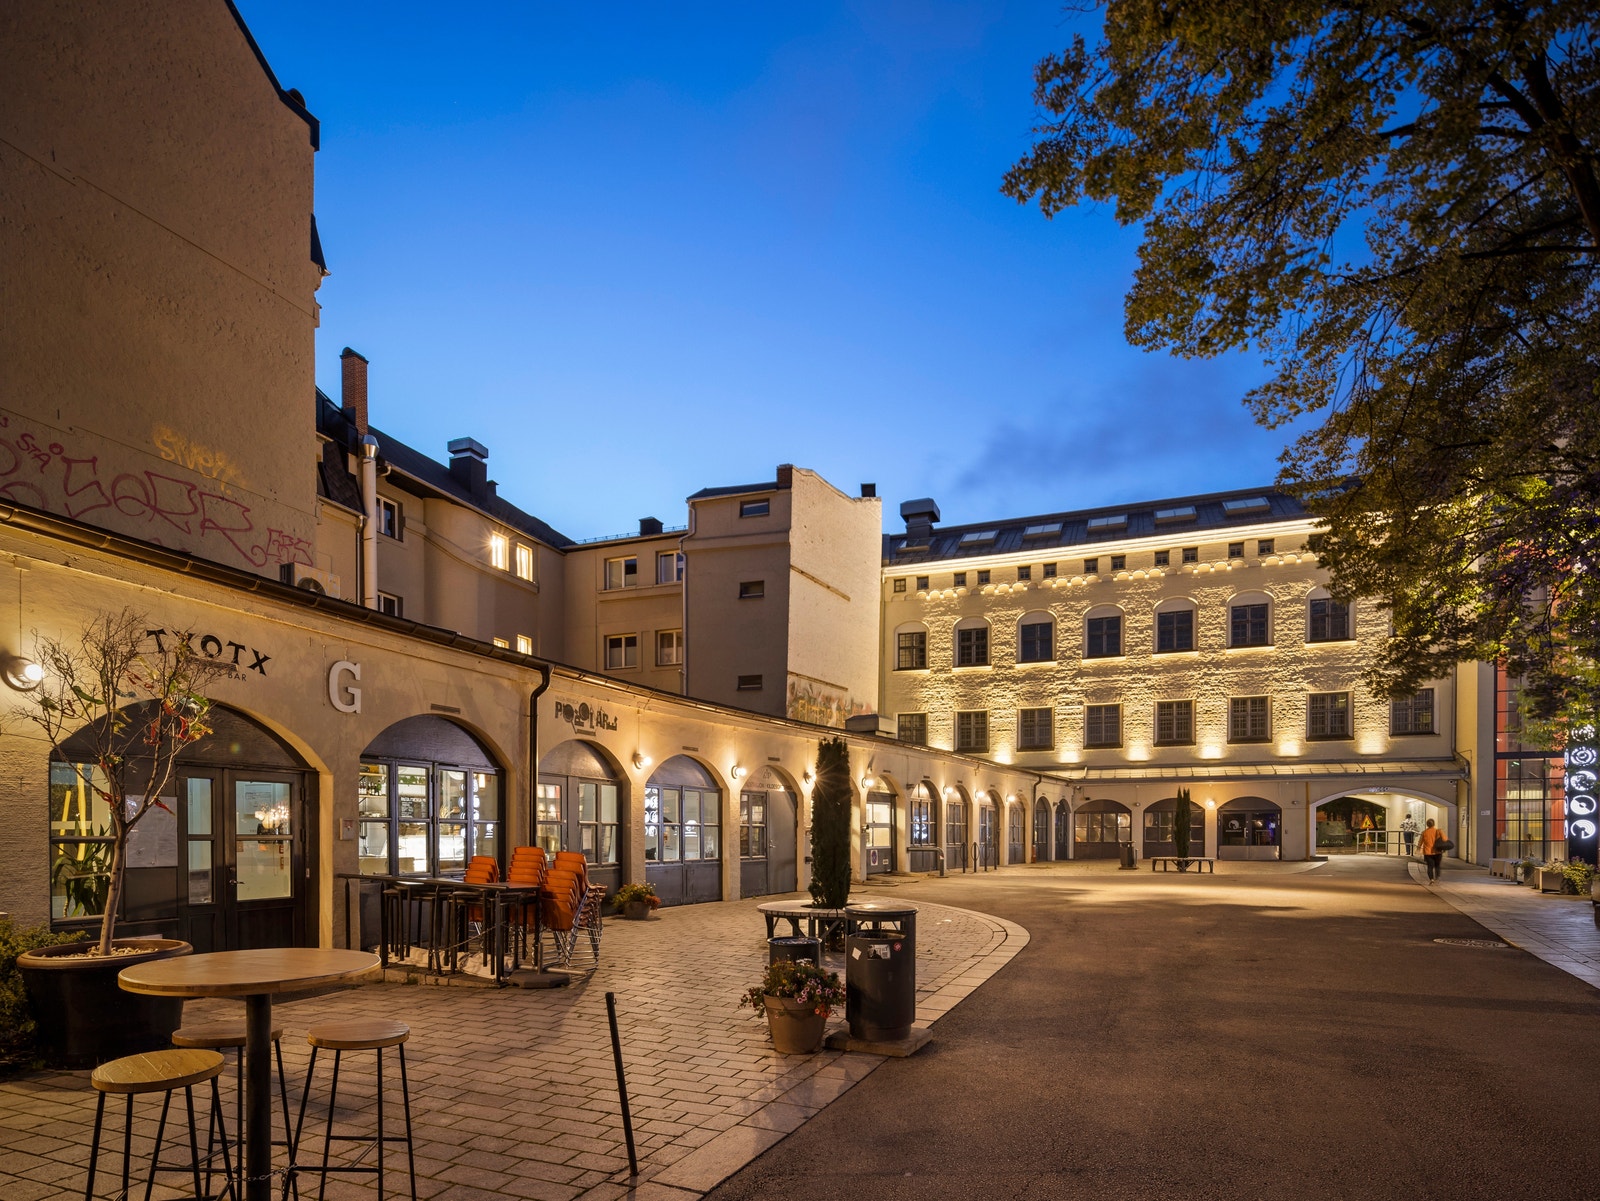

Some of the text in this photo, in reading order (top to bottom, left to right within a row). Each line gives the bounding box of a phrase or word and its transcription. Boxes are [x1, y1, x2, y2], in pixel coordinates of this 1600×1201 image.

[146, 628, 272, 677] TXOTX
[228, 669, 247, 681] BAR
[328, 660, 362, 714] G
